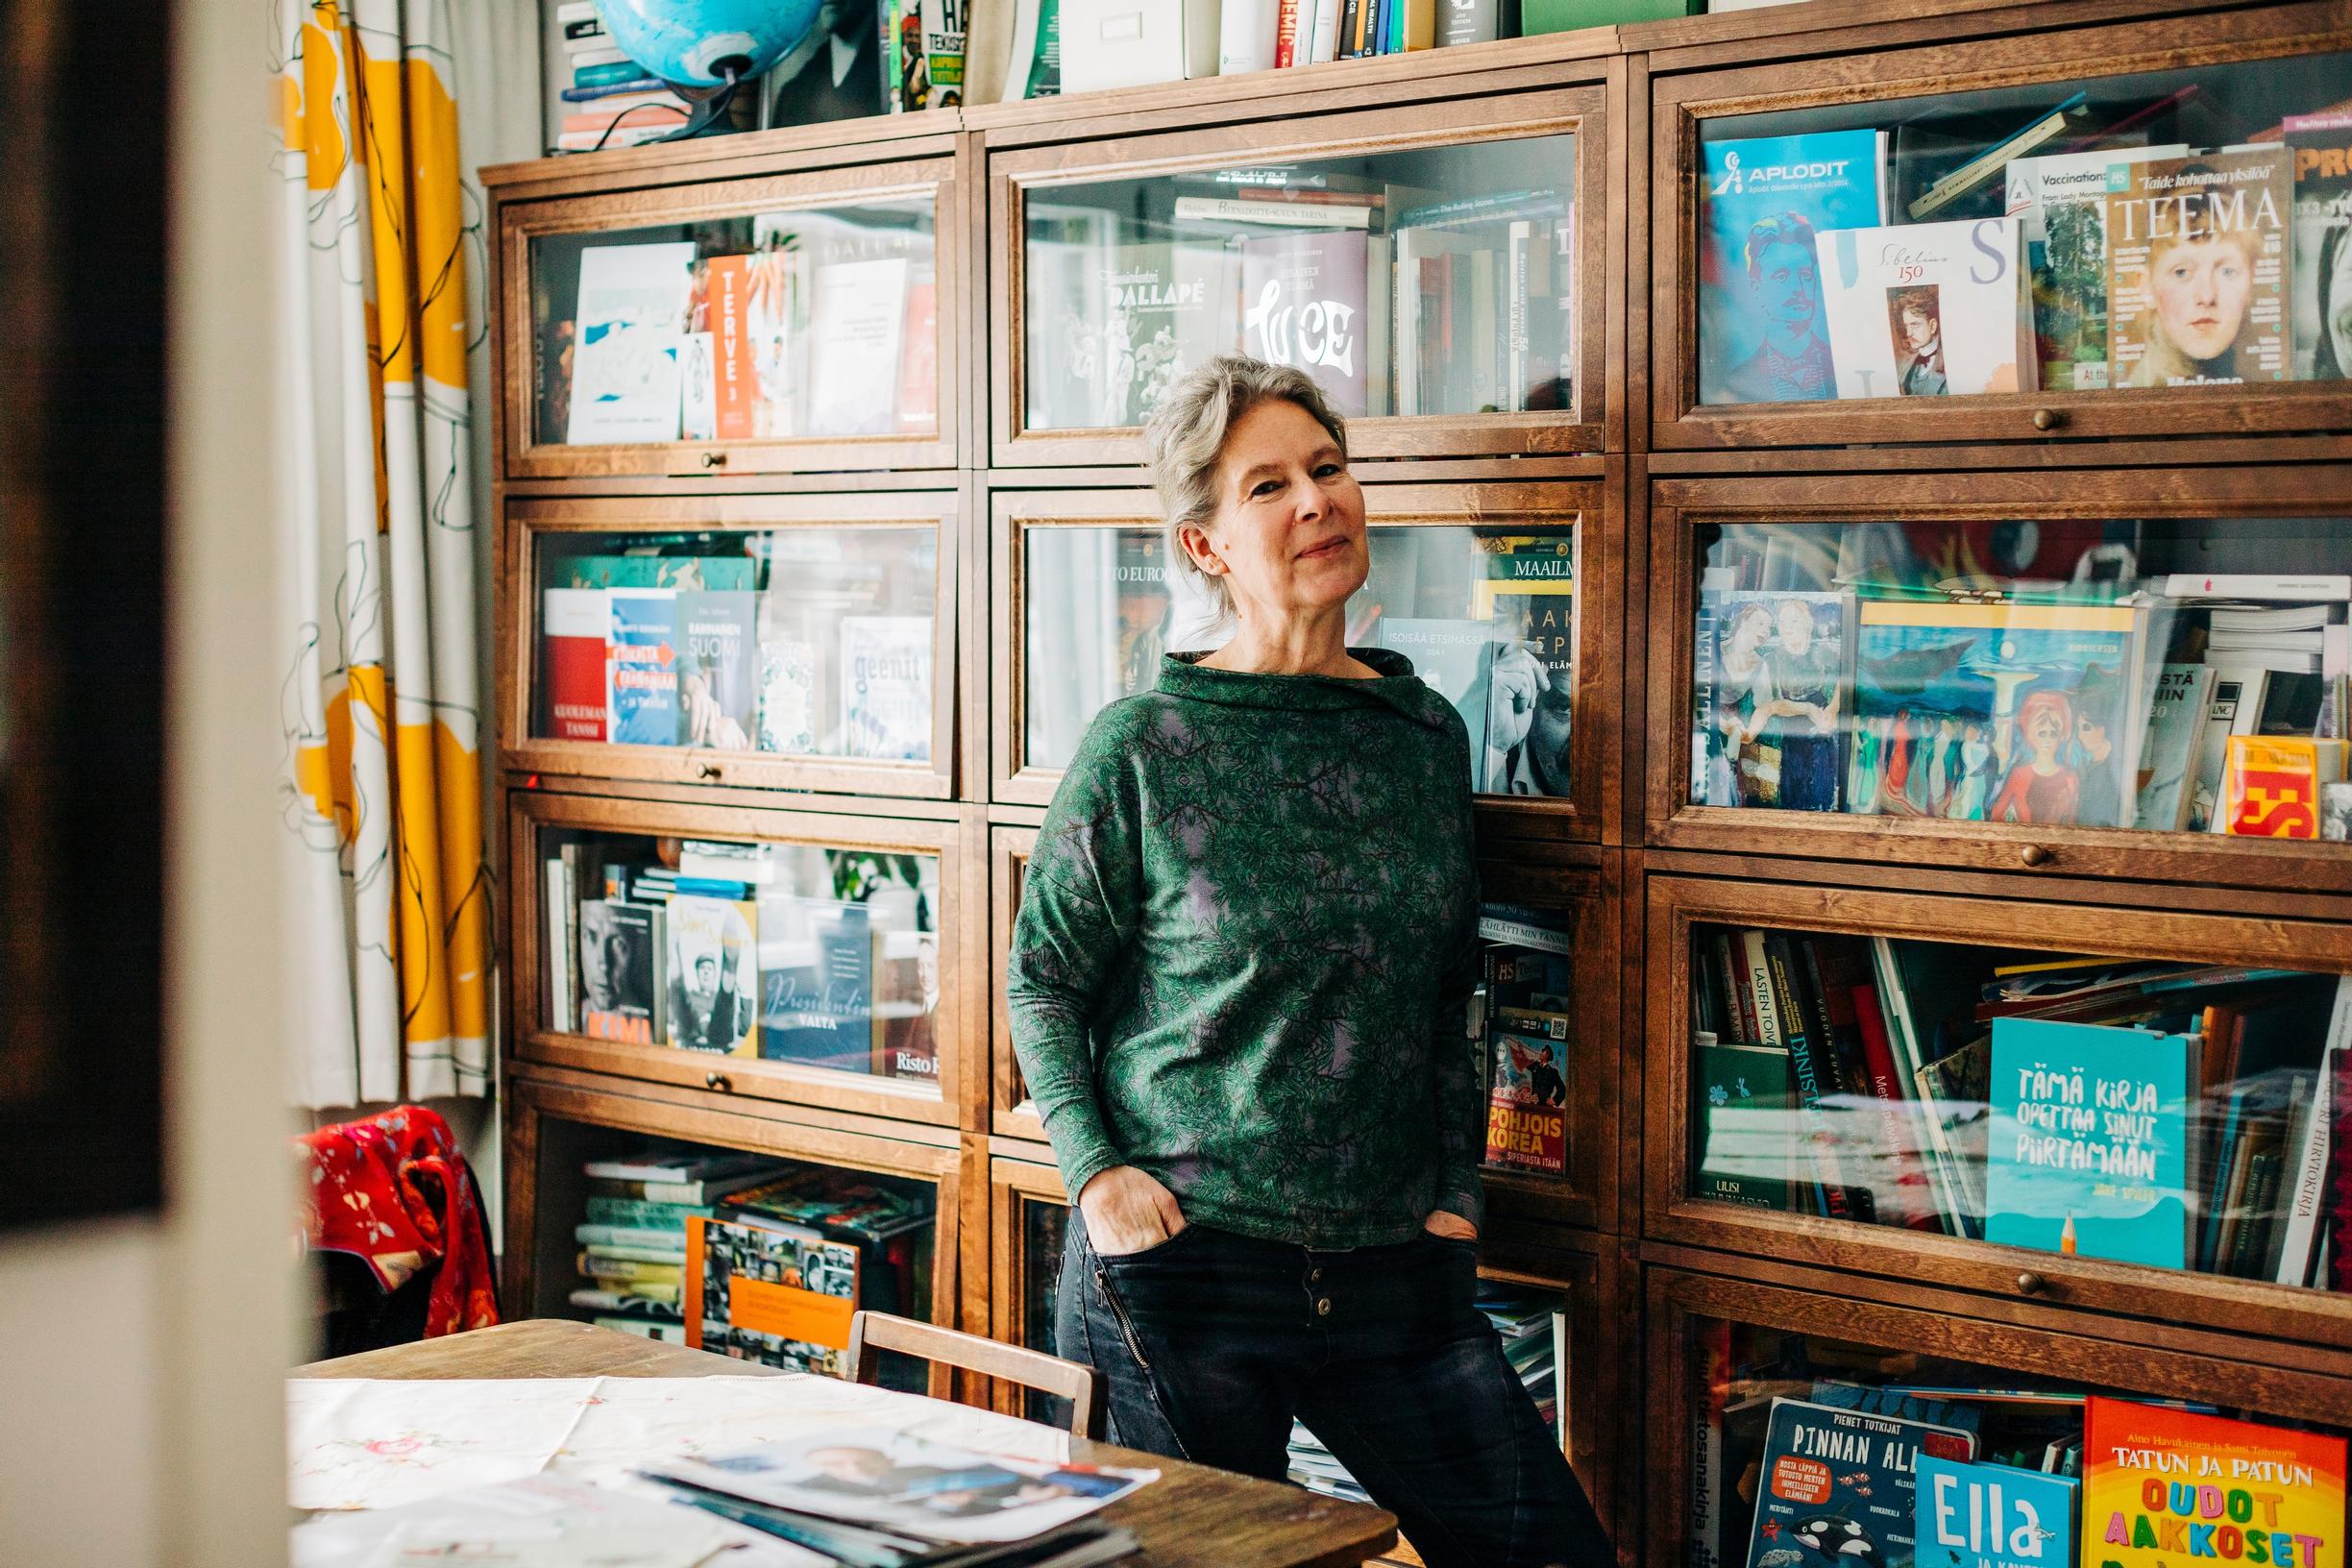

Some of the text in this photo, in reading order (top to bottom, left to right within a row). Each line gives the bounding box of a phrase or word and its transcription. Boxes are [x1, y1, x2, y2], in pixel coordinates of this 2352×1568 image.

[1367, 9, 1377, 34] HEALTH
[1748, 160, 1850, 183] APLODIT
[2042, 171, 2107, 185] Vaccination:
[2111, 170, 2126, 184] HS
[2061, 192, 2076, 201] Lady
[2079, 190, 2107, 200] Montag
[2113, 187, 2284, 240] TEEMA
[1899, 264, 1923, 284] 150
[1105, 278, 1205, 306] DALLAPÉ
[722, 271, 738, 381] TERVE
[1518, 336, 1529, 352] 56
[2096, 368, 2107, 380] th
[689, 637, 741, 658] SUOMI
[1697, 629, 1712, 746] SALLINEN
[1498, 963, 1515, 981] HS
[1753, 968, 1771, 1012] LASTEN
[588, 1010, 652, 1045] KIMI
[798, 1013, 838, 1031] VALTA
[895, 1051, 931, 1073] Risto
[2018, 1062, 2084, 1105] TÄMÄ
[1488, 1106, 1562, 1139] POHJOIS
[2018, 1102, 2095, 1133] OPETTAA
[1487, 1126, 1544, 1155] KOREA
[1507, 1151, 1561, 1169] SIPERIASTA ITÄÄN
[2297, 1129, 2328, 1218] HIRVIÖKIRJA
[1715, 1180, 1740, 1193] UUSI
[1833, 1412, 1902, 1435] PIENET TUTKIJAT
[1793, 1424, 1871, 1465] PINNAN
[2126, 1433, 2150, 1444] Aino
[1693, 1399, 1711, 1531] tietosanakirja
[2112, 1447, 2314, 1488] TATUN JA PATUN
[1933, 1473, 2043, 1558] Ella
[2142, 1478, 2283, 1527] OUDOT
[2104, 1511, 2323, 1568] AAKKOSET
